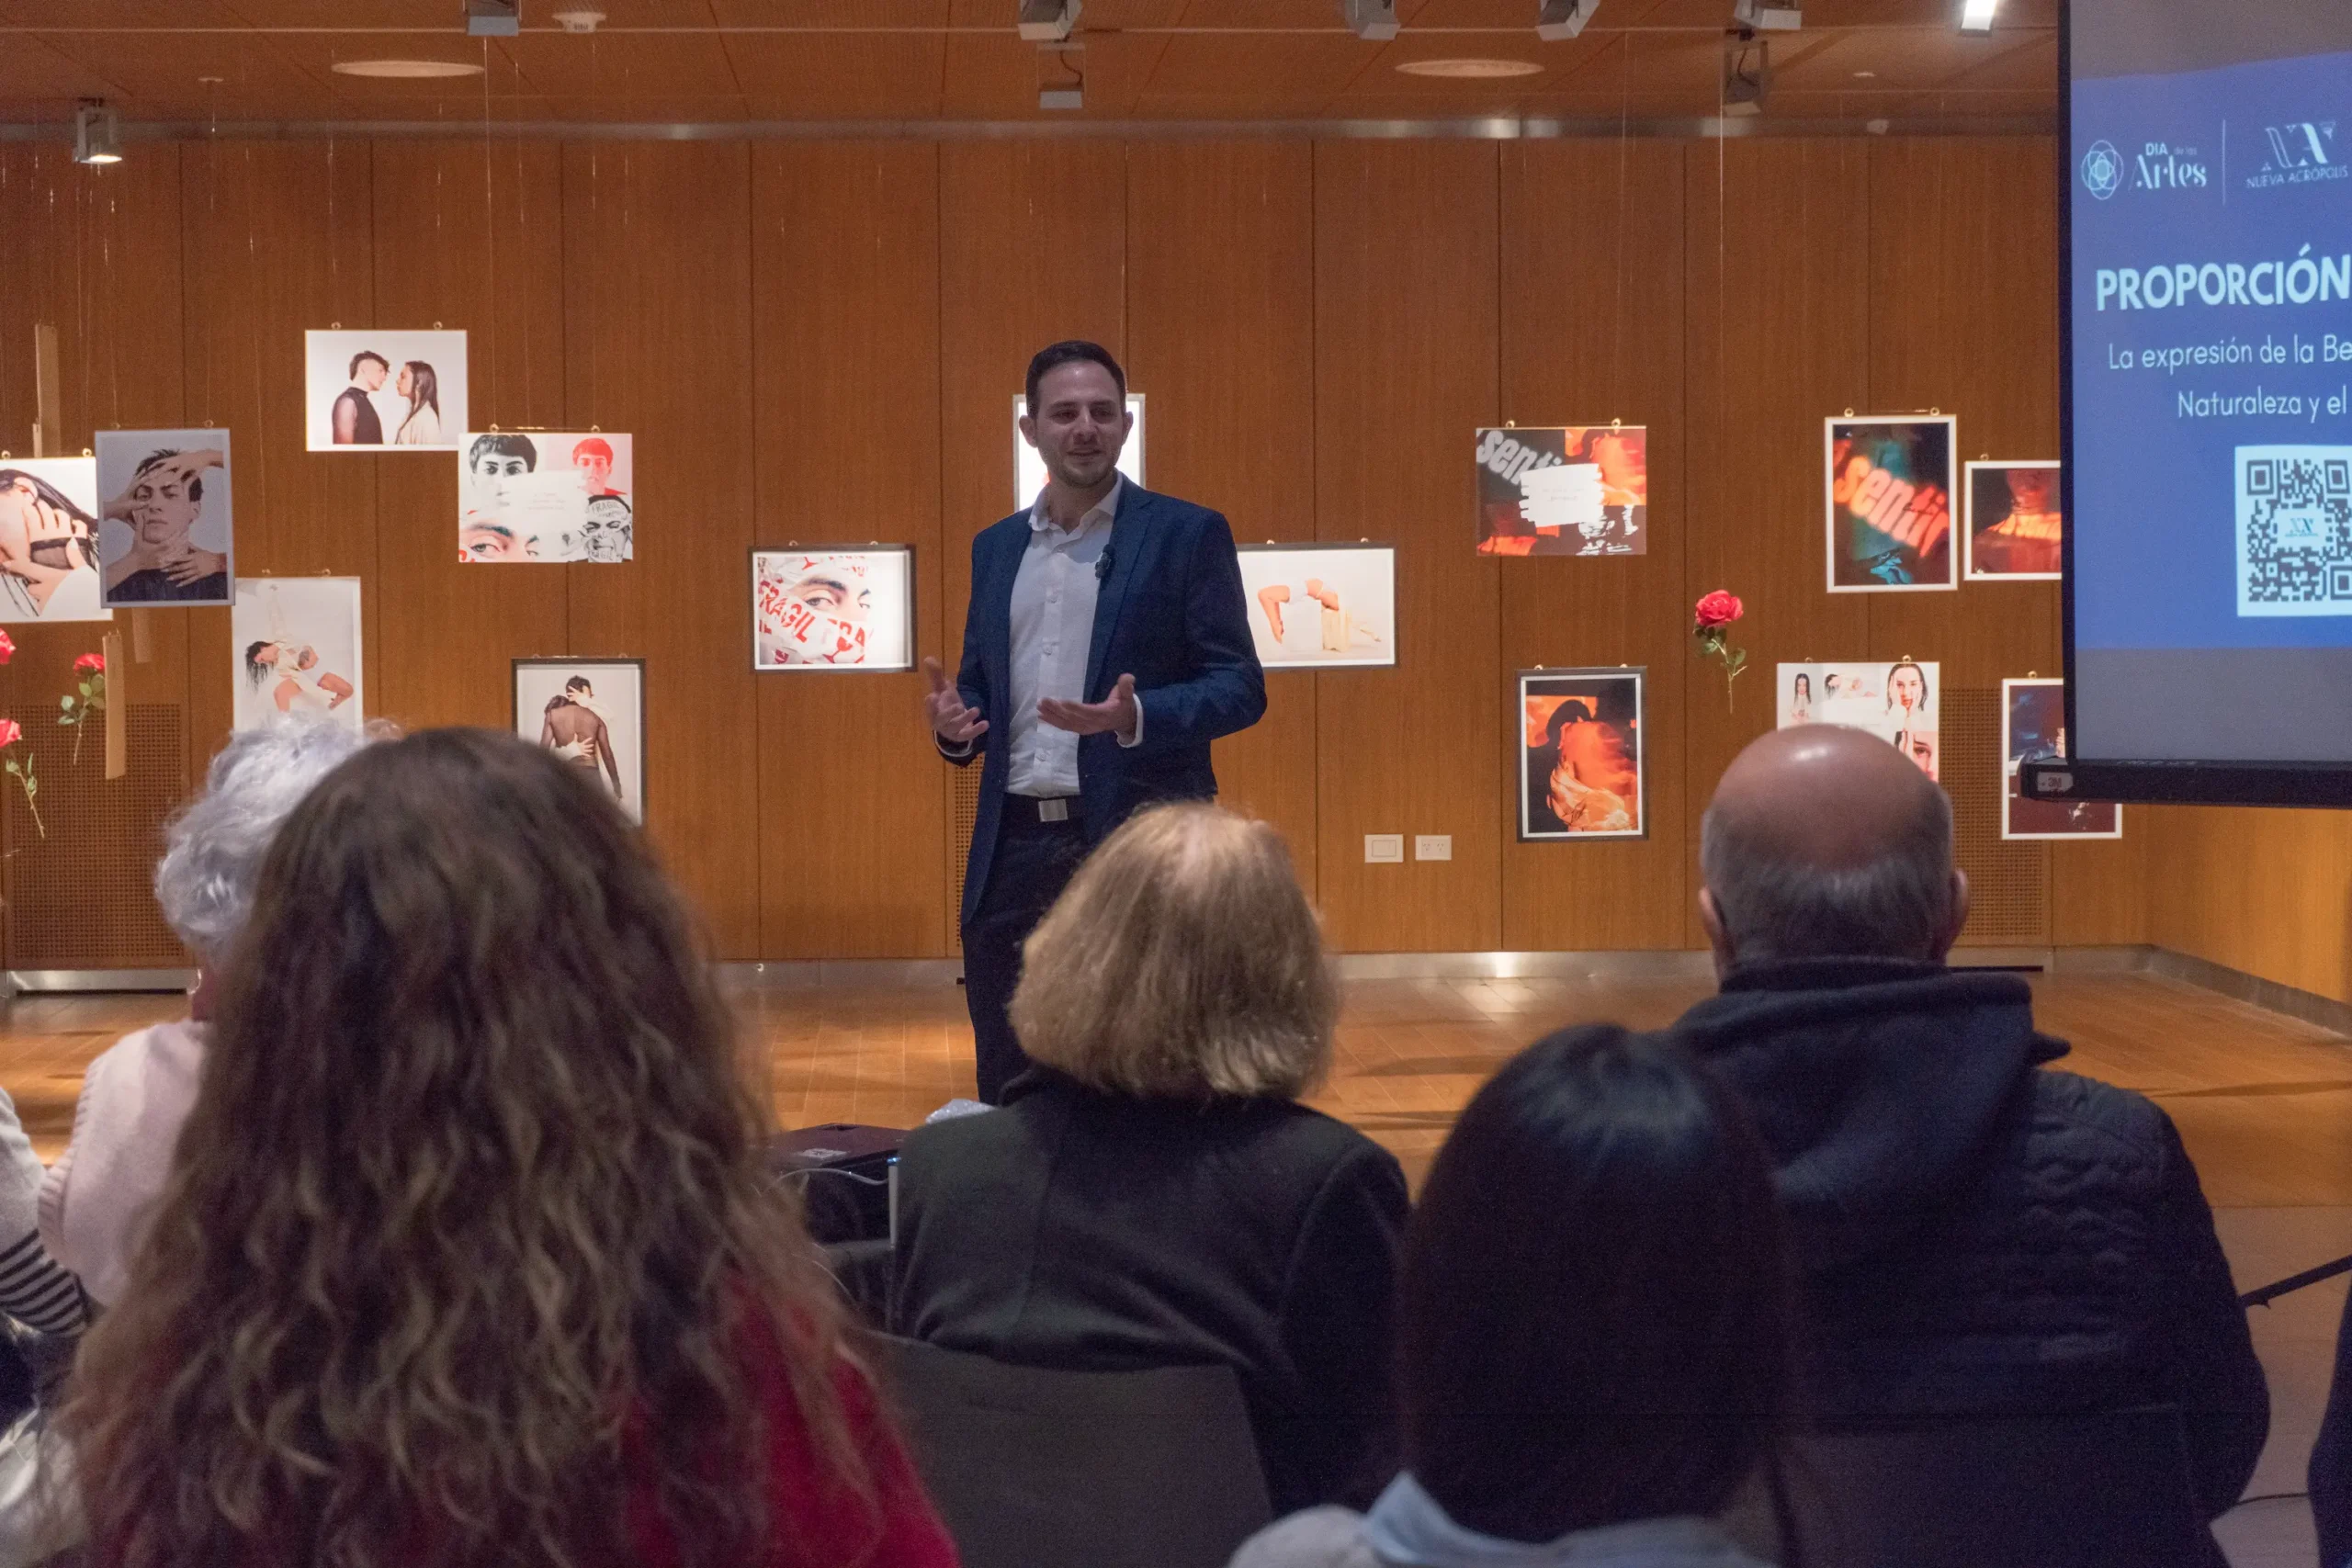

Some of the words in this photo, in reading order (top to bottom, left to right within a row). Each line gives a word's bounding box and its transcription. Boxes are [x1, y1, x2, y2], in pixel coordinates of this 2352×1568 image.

[2096, 242, 2352, 311] PROPORCIÓN
[2109, 343, 2133, 369] La
[2142, 336, 2252, 376] expresión
[2259, 334, 2287, 364] de
[2293, 333, 2314, 364] la
[2177, 385, 2302, 418] Naturaleza
[2308, 397, 2320, 424] y
[2326, 385, 2347, 415] el
